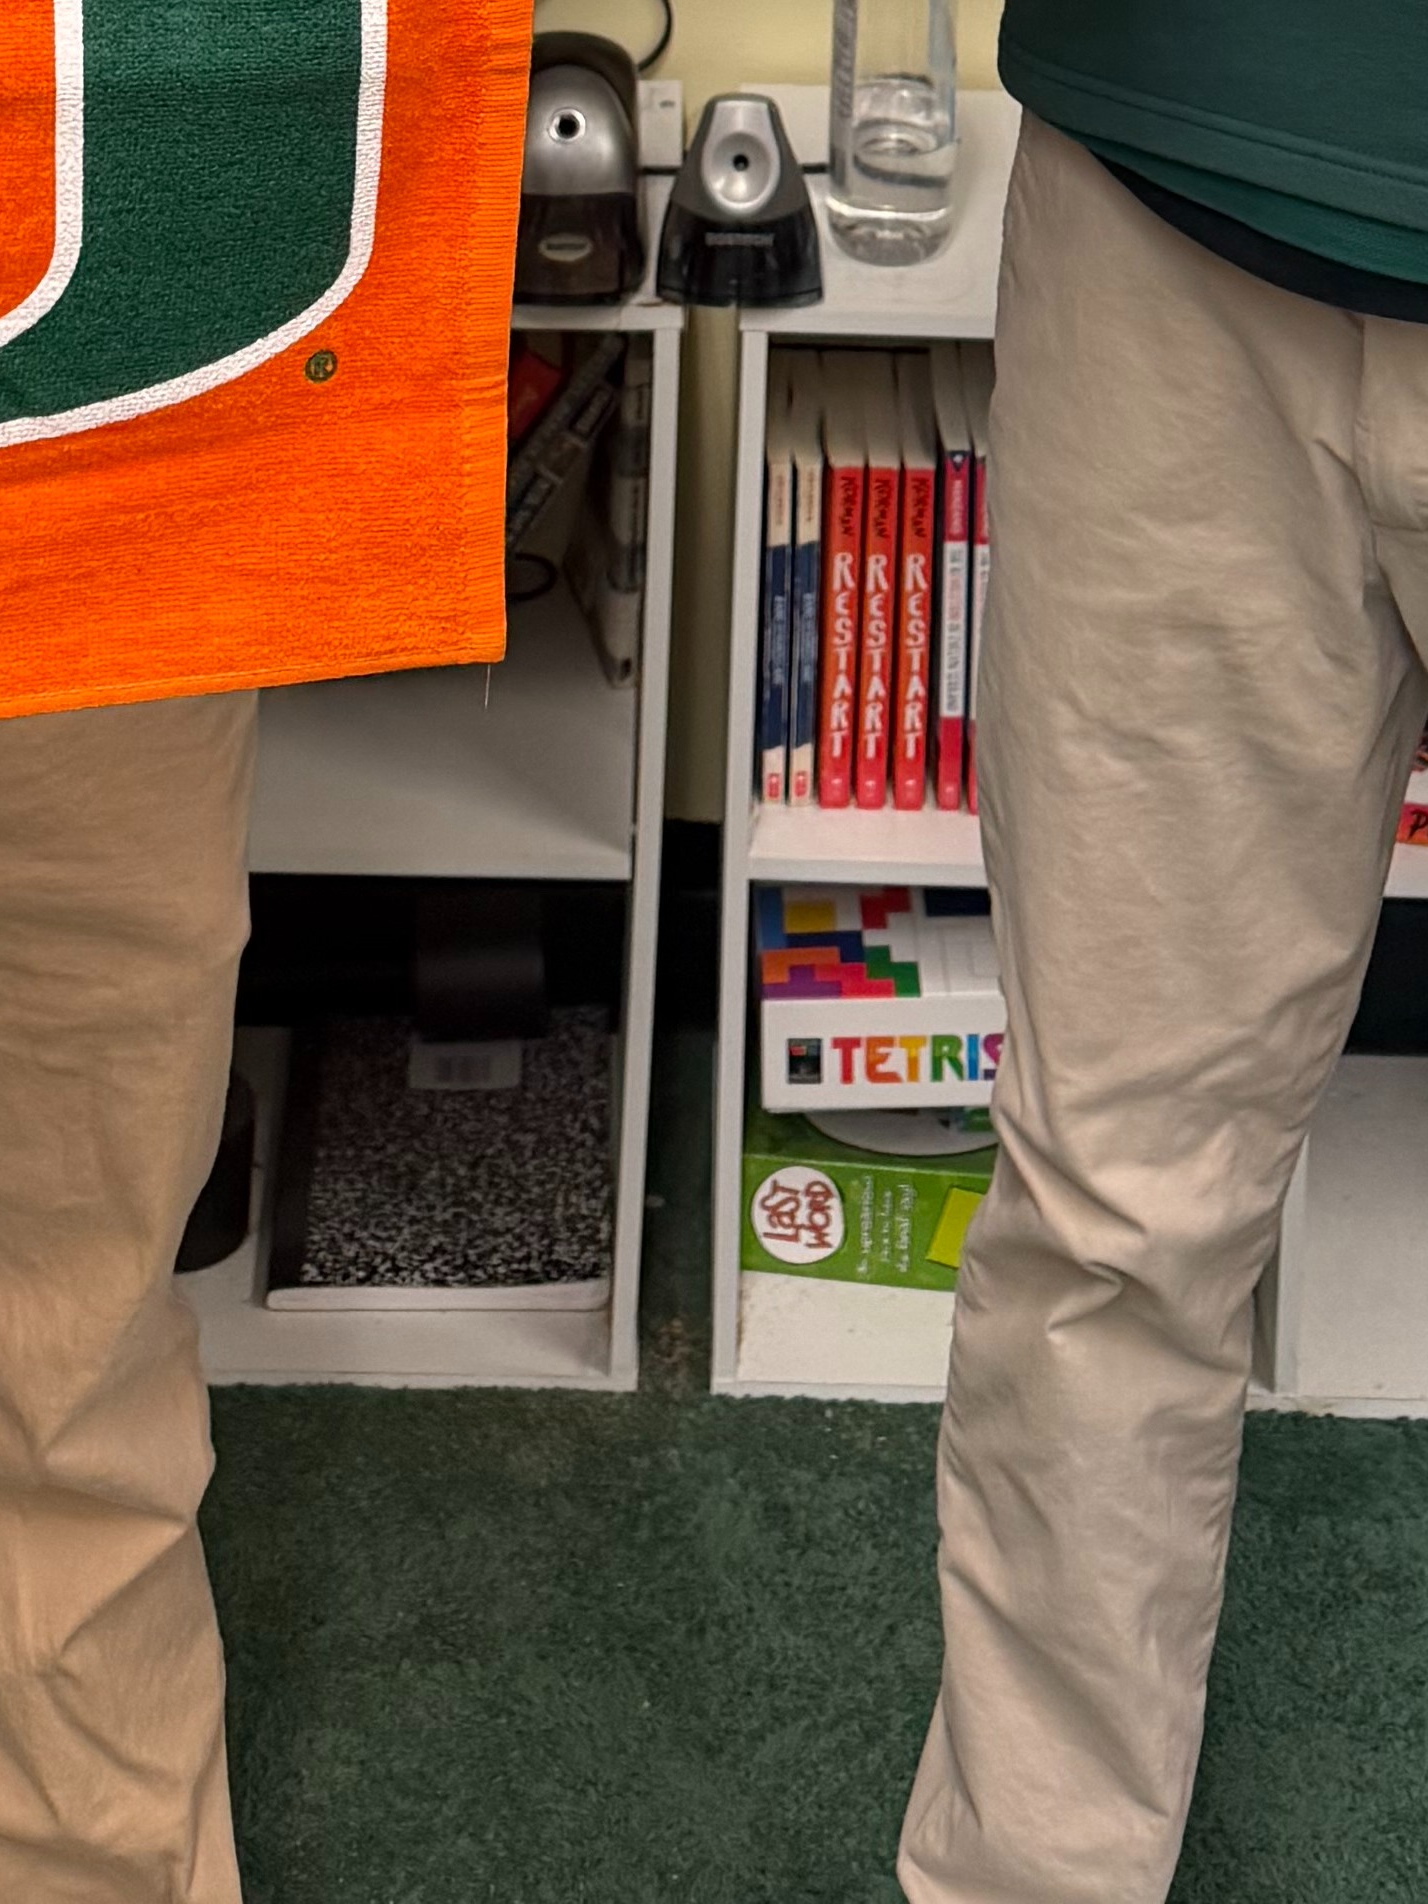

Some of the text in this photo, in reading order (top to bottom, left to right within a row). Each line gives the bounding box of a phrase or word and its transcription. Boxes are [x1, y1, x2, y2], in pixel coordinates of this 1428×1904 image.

[831, 551, 856, 759] RESTART
[865, 553, 889, 760] RESTART
[903, 553, 928, 760] RESTART
